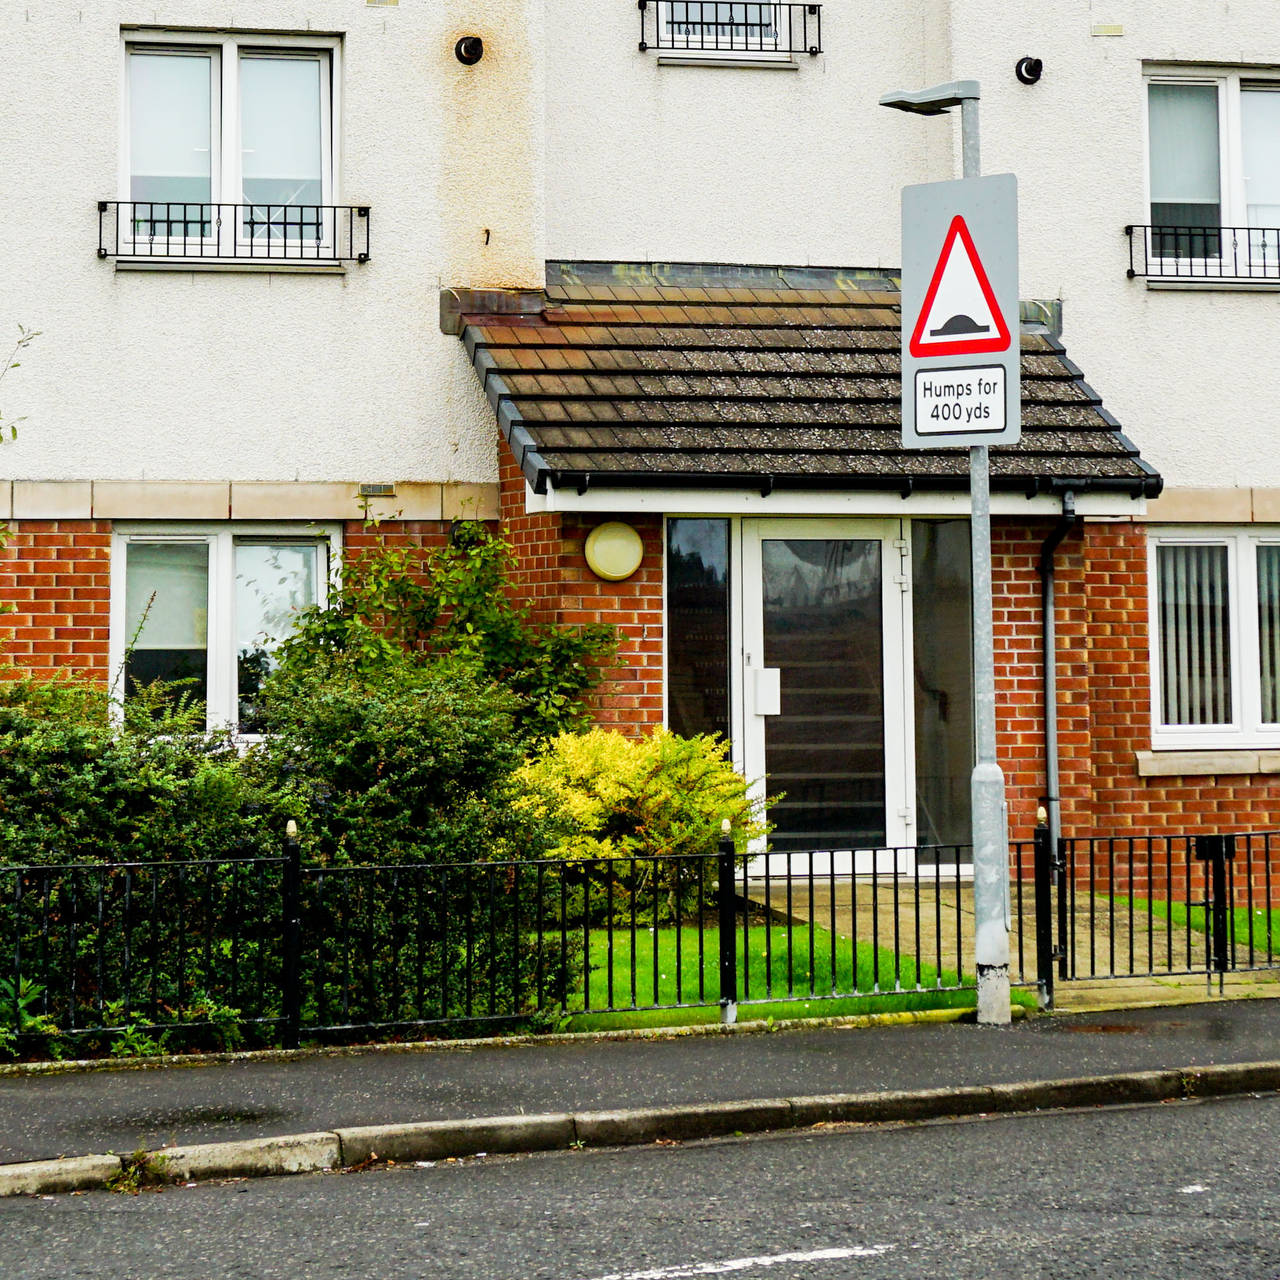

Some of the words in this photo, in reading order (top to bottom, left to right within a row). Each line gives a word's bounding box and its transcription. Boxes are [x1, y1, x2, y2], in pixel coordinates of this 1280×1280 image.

[923, 381, 972, 399] Humps
[978, 378, 998, 395] for
[930, 403, 962, 421] 400
[965, 402, 990, 423] yds
